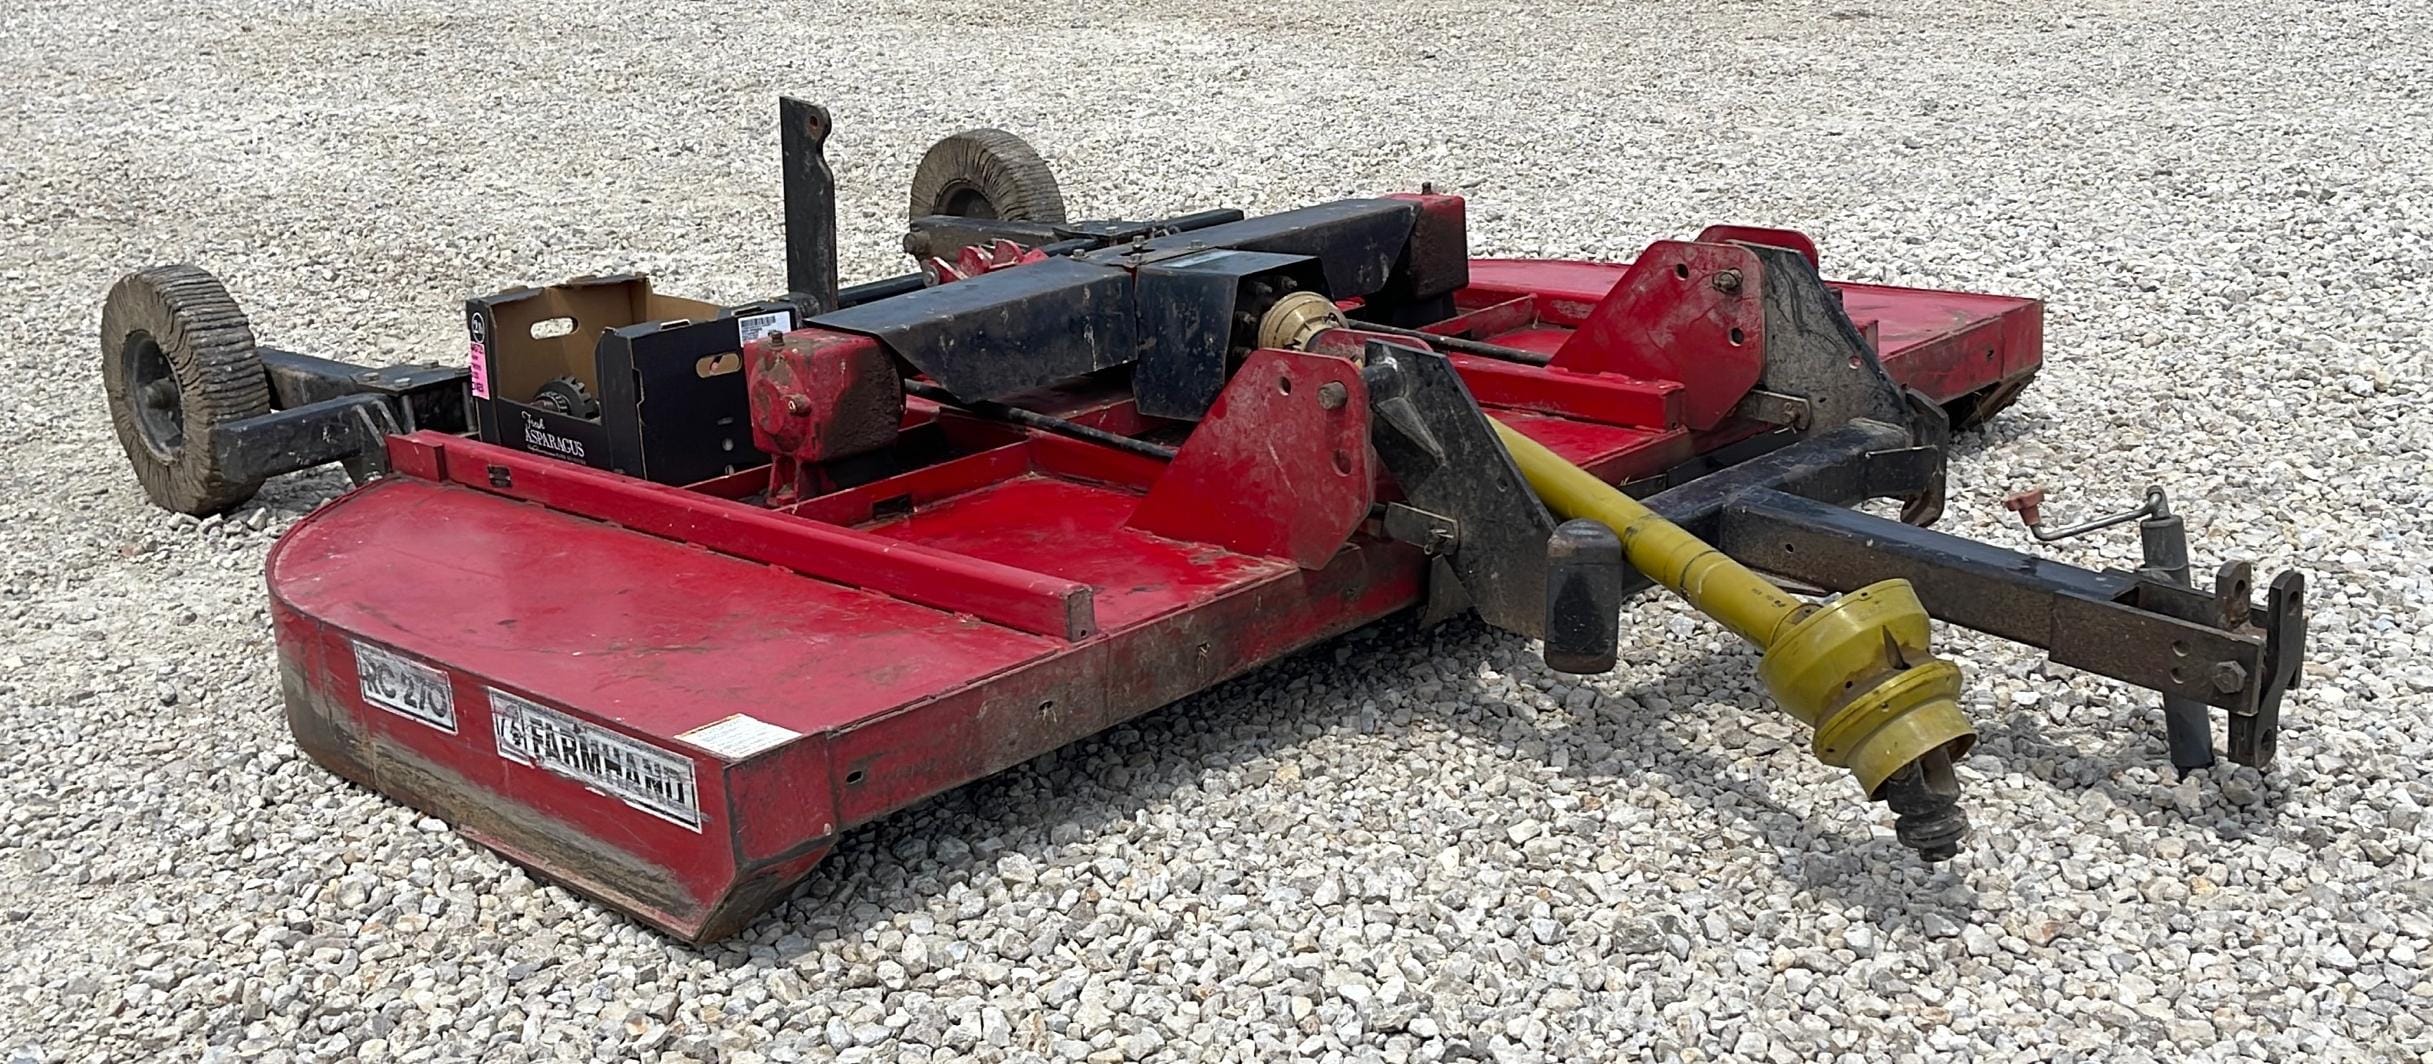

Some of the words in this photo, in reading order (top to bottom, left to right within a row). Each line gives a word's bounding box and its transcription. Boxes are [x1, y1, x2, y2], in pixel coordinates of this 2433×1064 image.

[525, 424, 585, 458] ASPARAGUS
[362, 661, 397, 699] RC
[400, 671, 448, 718] 270
[528, 718, 687, 804] FARMHAND
